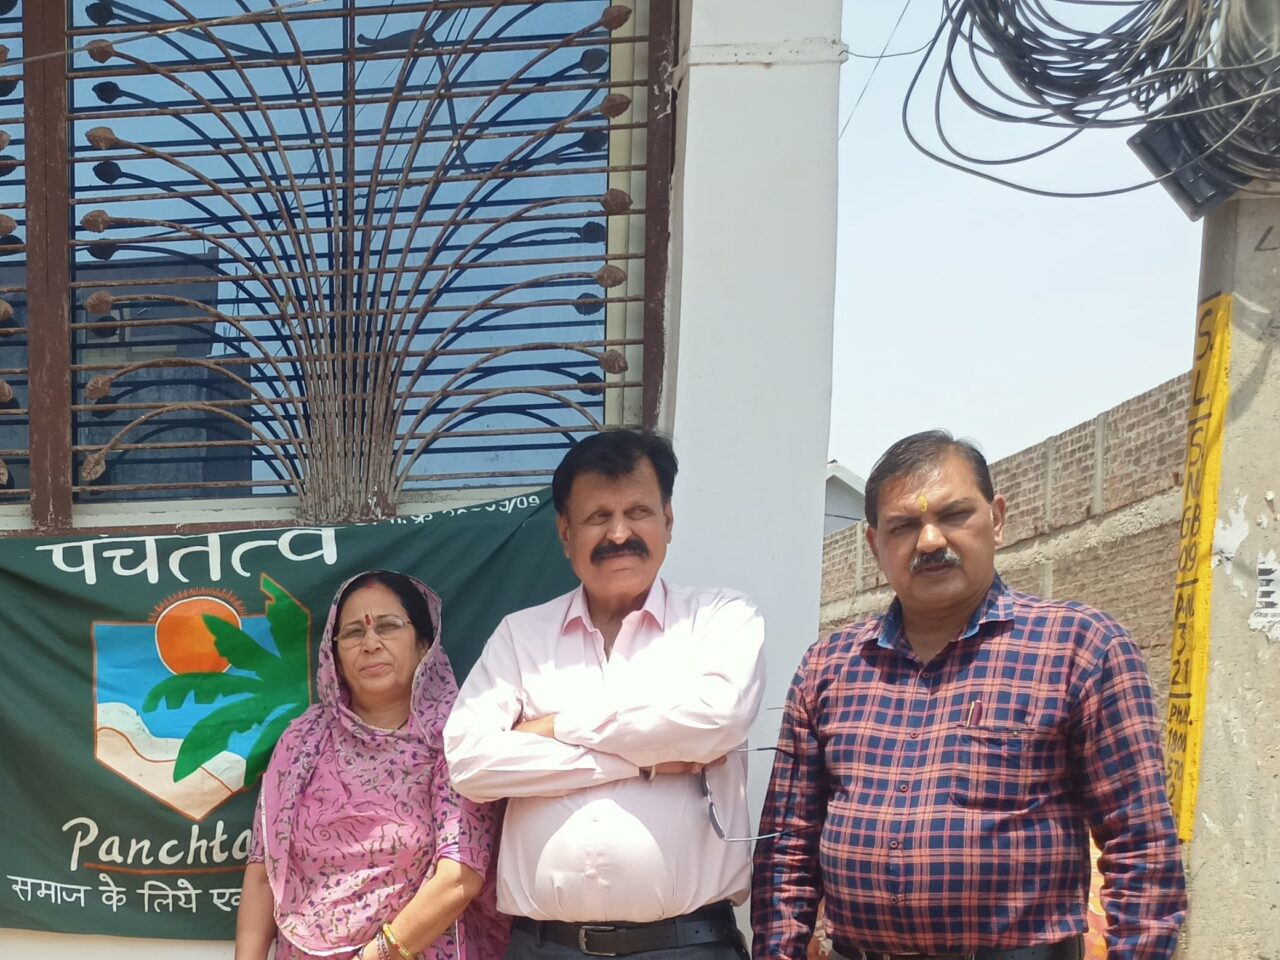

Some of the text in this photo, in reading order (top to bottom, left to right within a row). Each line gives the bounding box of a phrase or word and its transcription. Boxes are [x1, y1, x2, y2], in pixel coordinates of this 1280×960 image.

[1171, 658, 1190, 686] 21
[62, 816, 252, 871] Panchta
[7, 875, 92, 907] समाज
[99, 872, 127, 912] के
[136, 879, 203, 913] लिये
